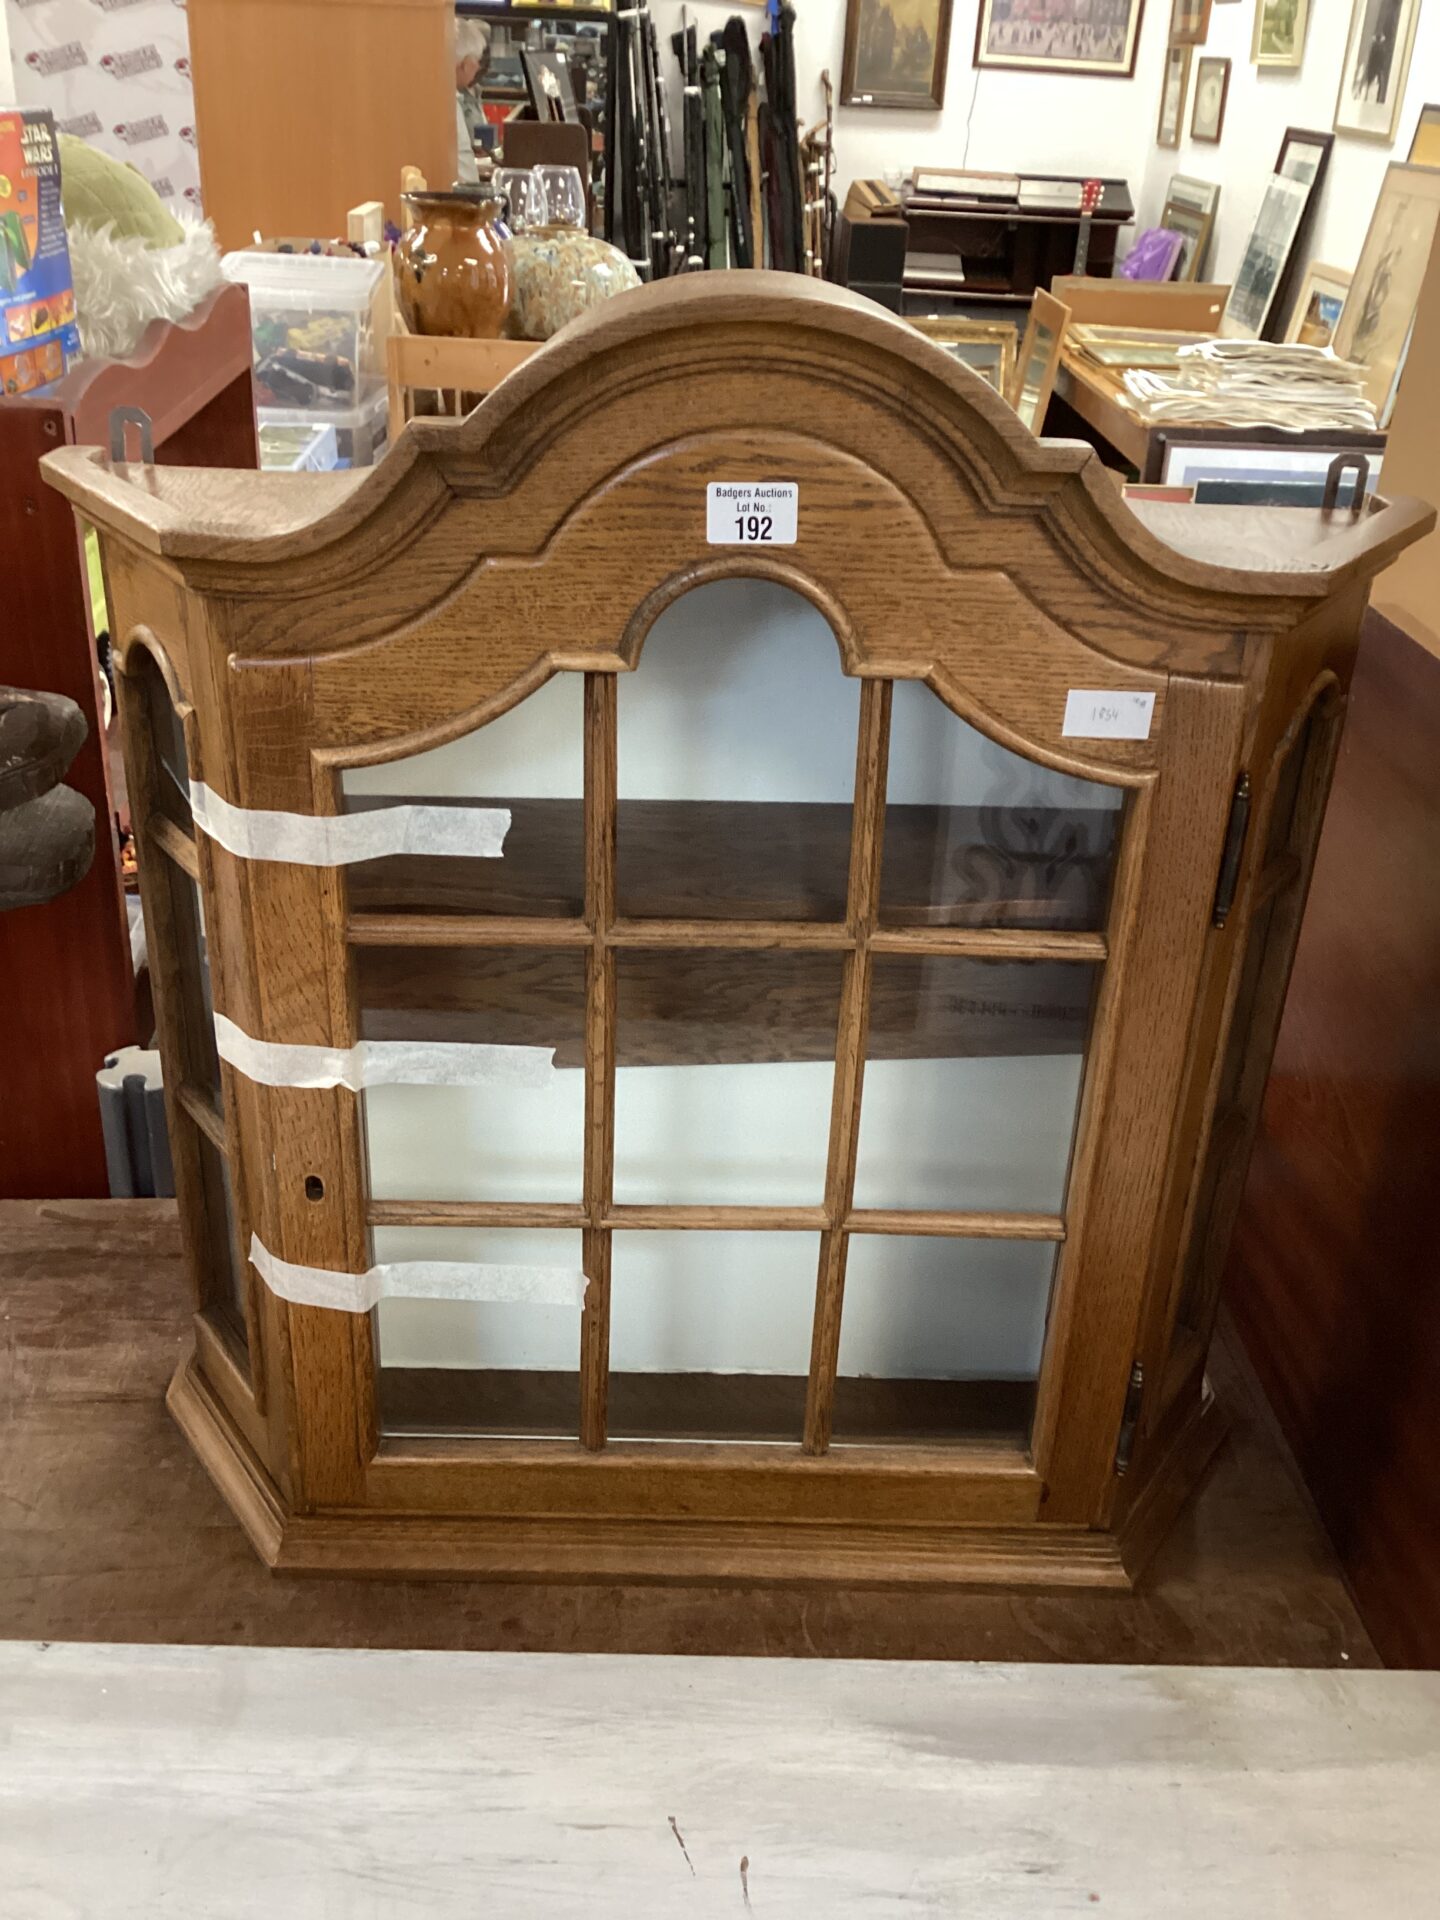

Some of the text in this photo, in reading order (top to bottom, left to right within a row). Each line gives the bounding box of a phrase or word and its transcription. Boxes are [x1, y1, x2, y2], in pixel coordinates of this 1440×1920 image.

[21, 122, 52, 144] STAR
[22, 143, 54, 165] WARS
[716, 487, 793, 499] Badgers Auctions
[736, 502, 750, 513] Lot
[735, 516, 773, 541] 192
